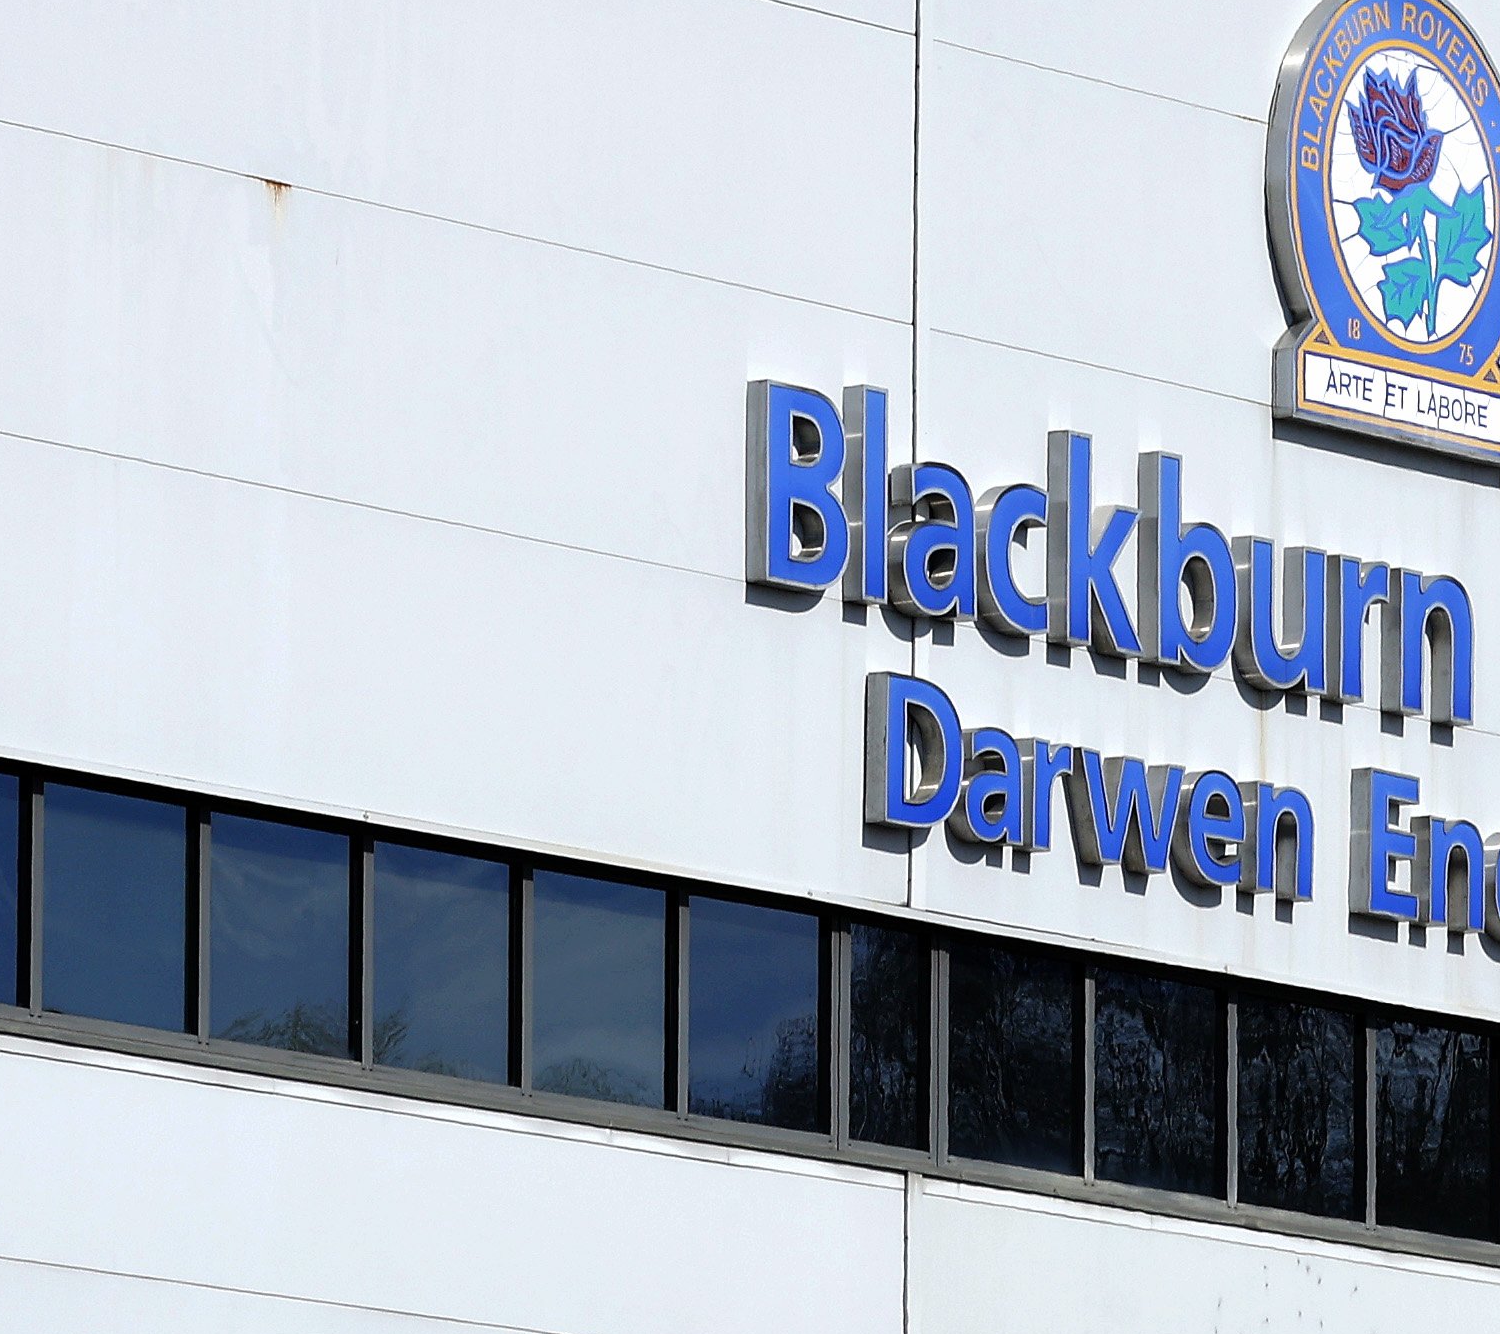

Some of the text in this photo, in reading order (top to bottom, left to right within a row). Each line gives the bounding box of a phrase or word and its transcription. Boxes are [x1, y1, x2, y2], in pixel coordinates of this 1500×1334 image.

[1301, 0, 1391, 171] BLACKBURN
[1401, 2, 1489, 107] ROVERS
[1326, 370, 1488, 428] ARTE ET LABORE
[1348, 317, 1474, 366] 18 75
[749, 380, 1474, 725] Blackburn
[867, 671, 1315, 901] Darwen
